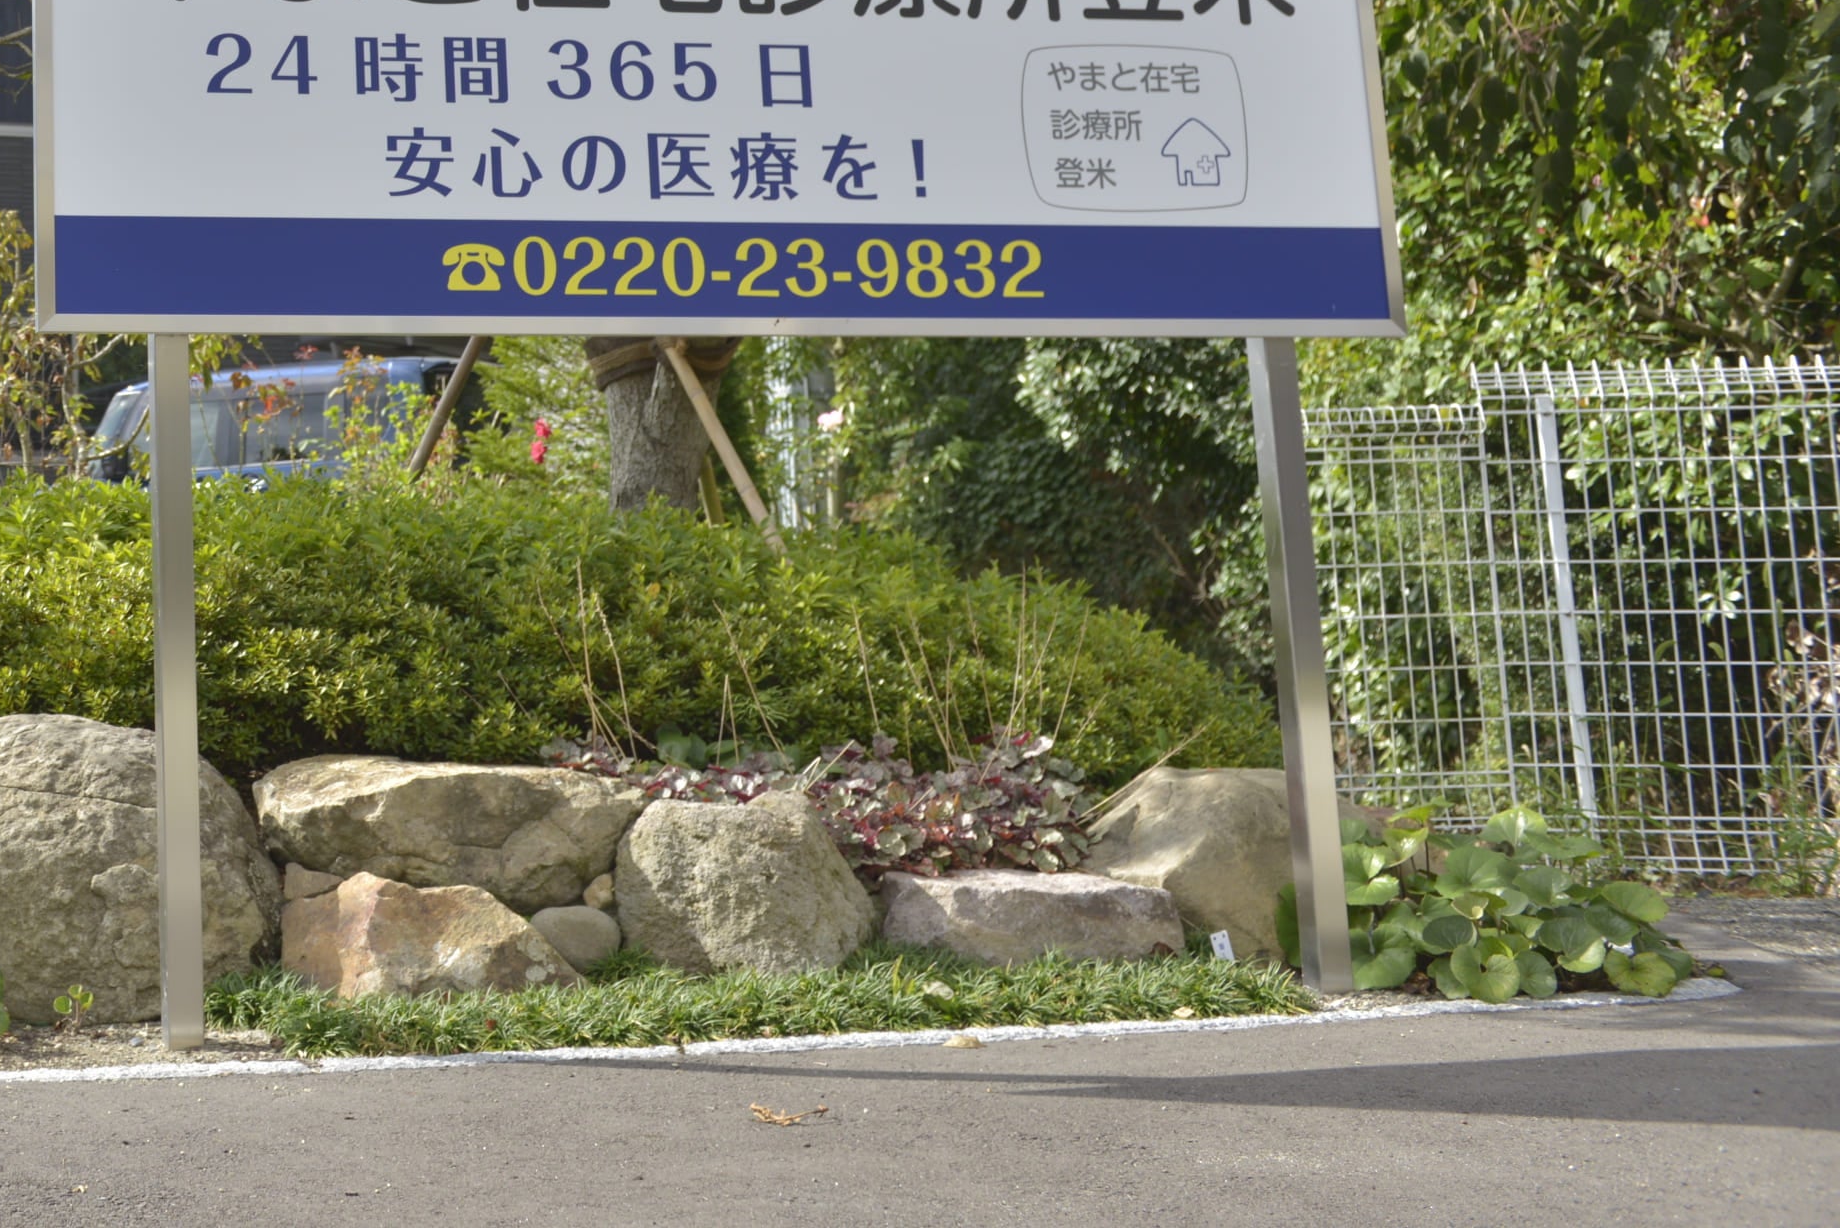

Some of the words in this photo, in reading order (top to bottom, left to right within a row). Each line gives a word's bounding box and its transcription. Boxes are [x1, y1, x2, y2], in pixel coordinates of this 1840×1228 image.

[1047, 61, 1201, 94] やまと在宅
[1050, 108, 1143, 141] 診療所
[384, 126, 927, 202] 安心の医療を！
[1054, 157, 1117, 190] 登米
[513, 235, 1045, 299] 0220-23-9832
